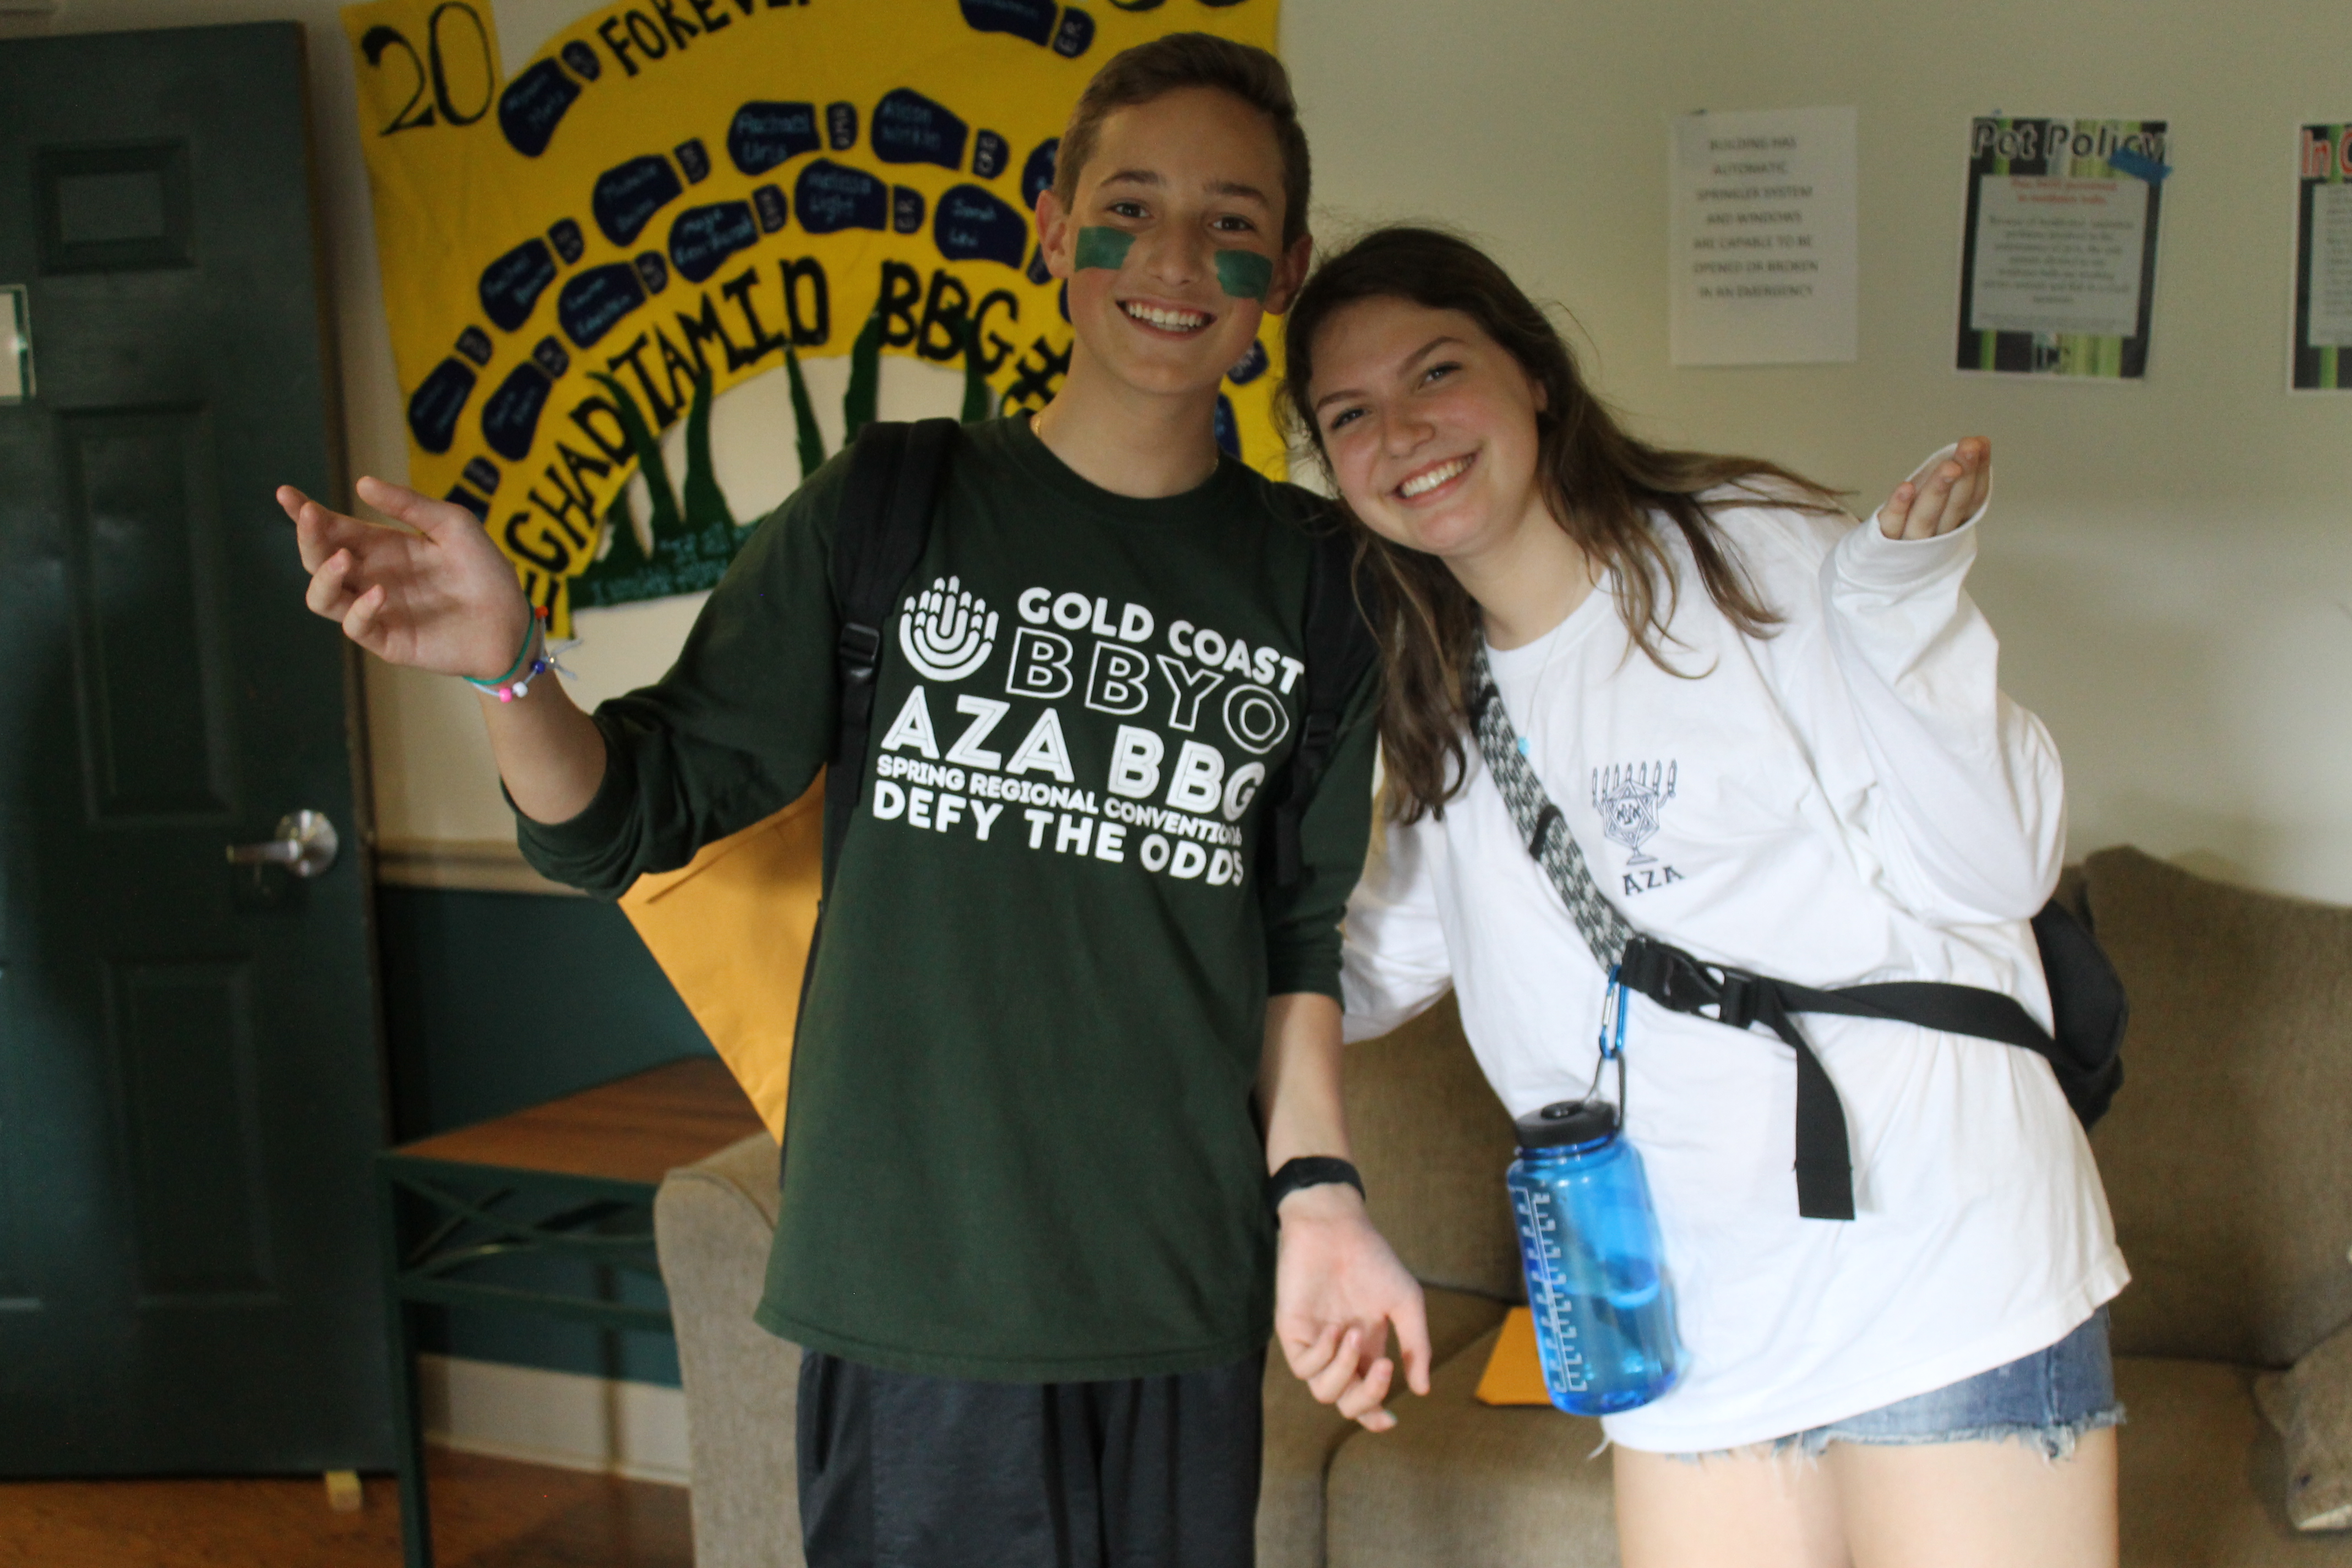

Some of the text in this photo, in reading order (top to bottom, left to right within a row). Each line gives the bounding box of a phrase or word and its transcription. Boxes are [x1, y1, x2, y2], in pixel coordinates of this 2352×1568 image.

[361, 2, 496, 137] 20
[597, 0, 810, 77] FORE
[880, 260, 1019, 375] BBG
[1005, 627, 1290, 754] BBYO
[1017, 587, 1305, 695] GOLD COAST
[877, 754, 964, 791] SPRING
[970, 772, 1099, 815] REGIONAL
[880, 685, 1265, 821] AZA BBG
[873, 780, 1243, 886] DEFY THE ODDS
[1623, 865, 1685, 896] AZA
